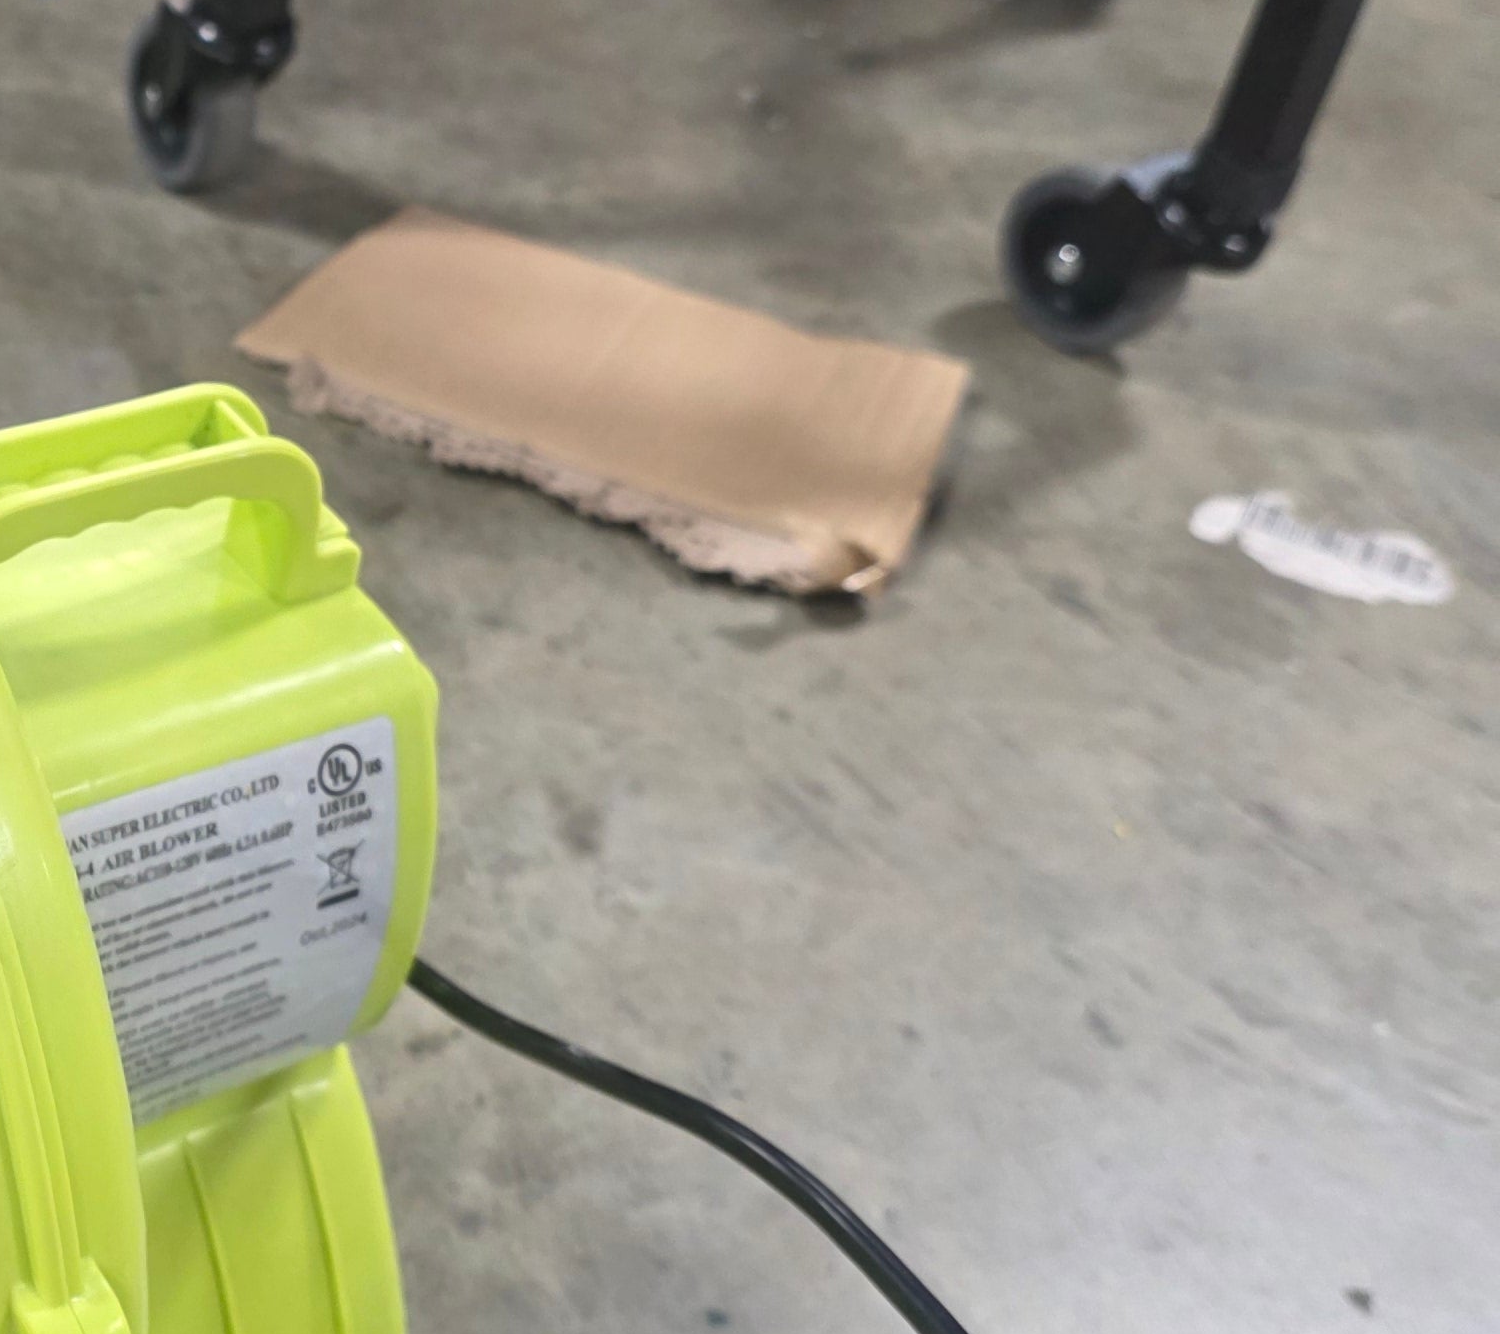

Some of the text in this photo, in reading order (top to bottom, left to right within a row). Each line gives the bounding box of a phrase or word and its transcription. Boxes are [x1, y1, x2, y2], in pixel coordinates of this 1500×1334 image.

[91, 819, 139, 848] SUPER
[143, 793, 218, 831] ELECTRIC
[320, 791, 366, 818] LISTED
[102, 849, 135, 873] AIR
[140, 822, 218, 860] BLOWER
